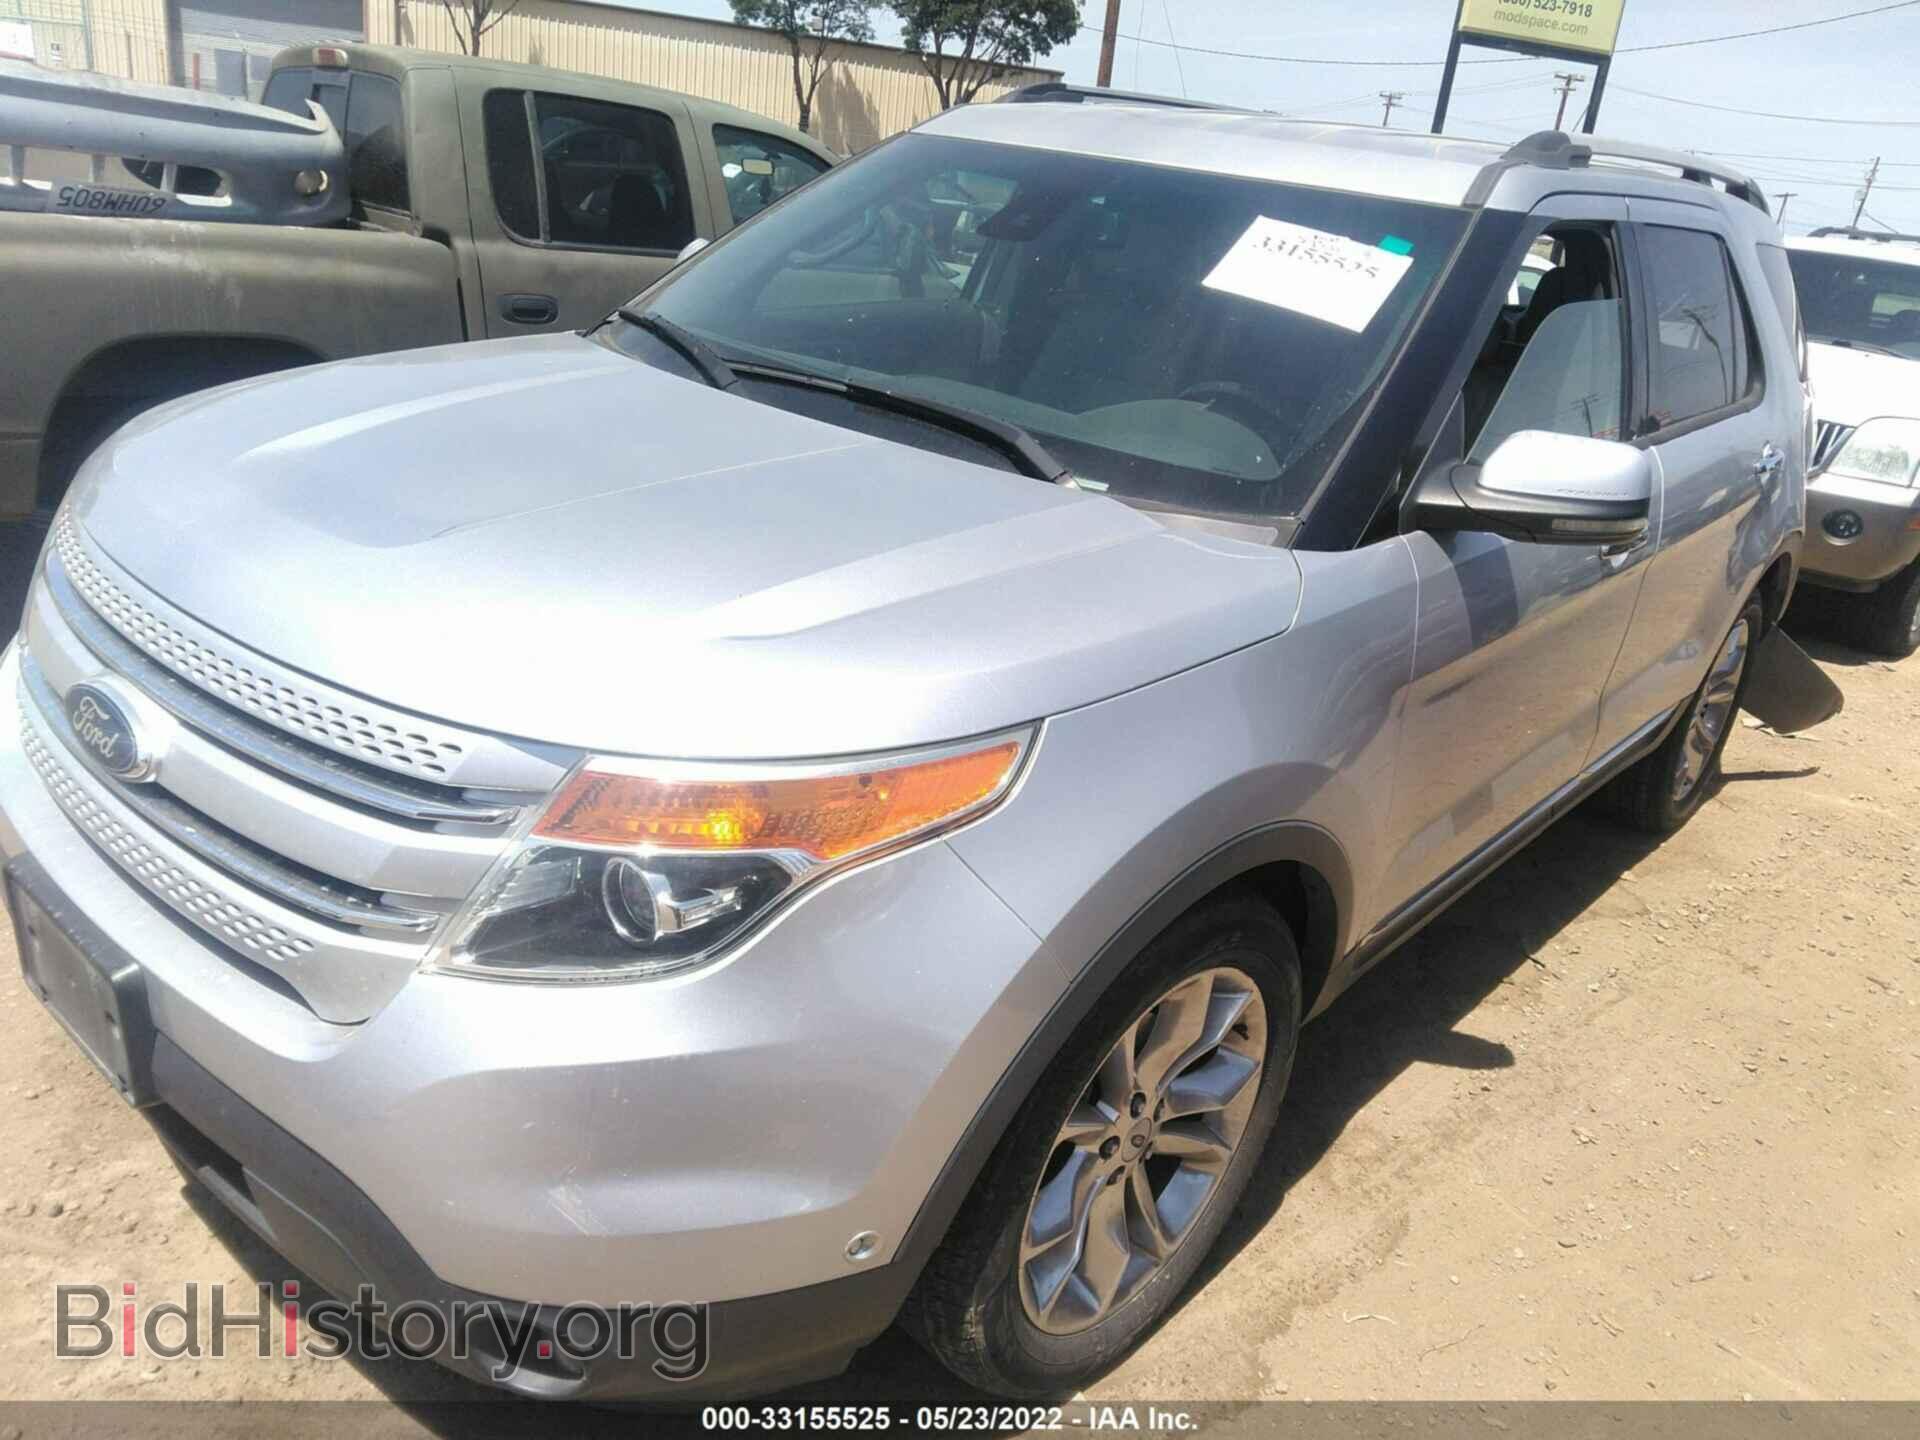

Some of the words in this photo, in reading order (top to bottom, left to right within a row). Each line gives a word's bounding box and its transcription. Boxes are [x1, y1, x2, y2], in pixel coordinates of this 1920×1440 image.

[1533, 0, 1593, 18] 523-7918
[1493, 10, 1588, 35] modspace.com
[72, 696, 120, 758] Ford
